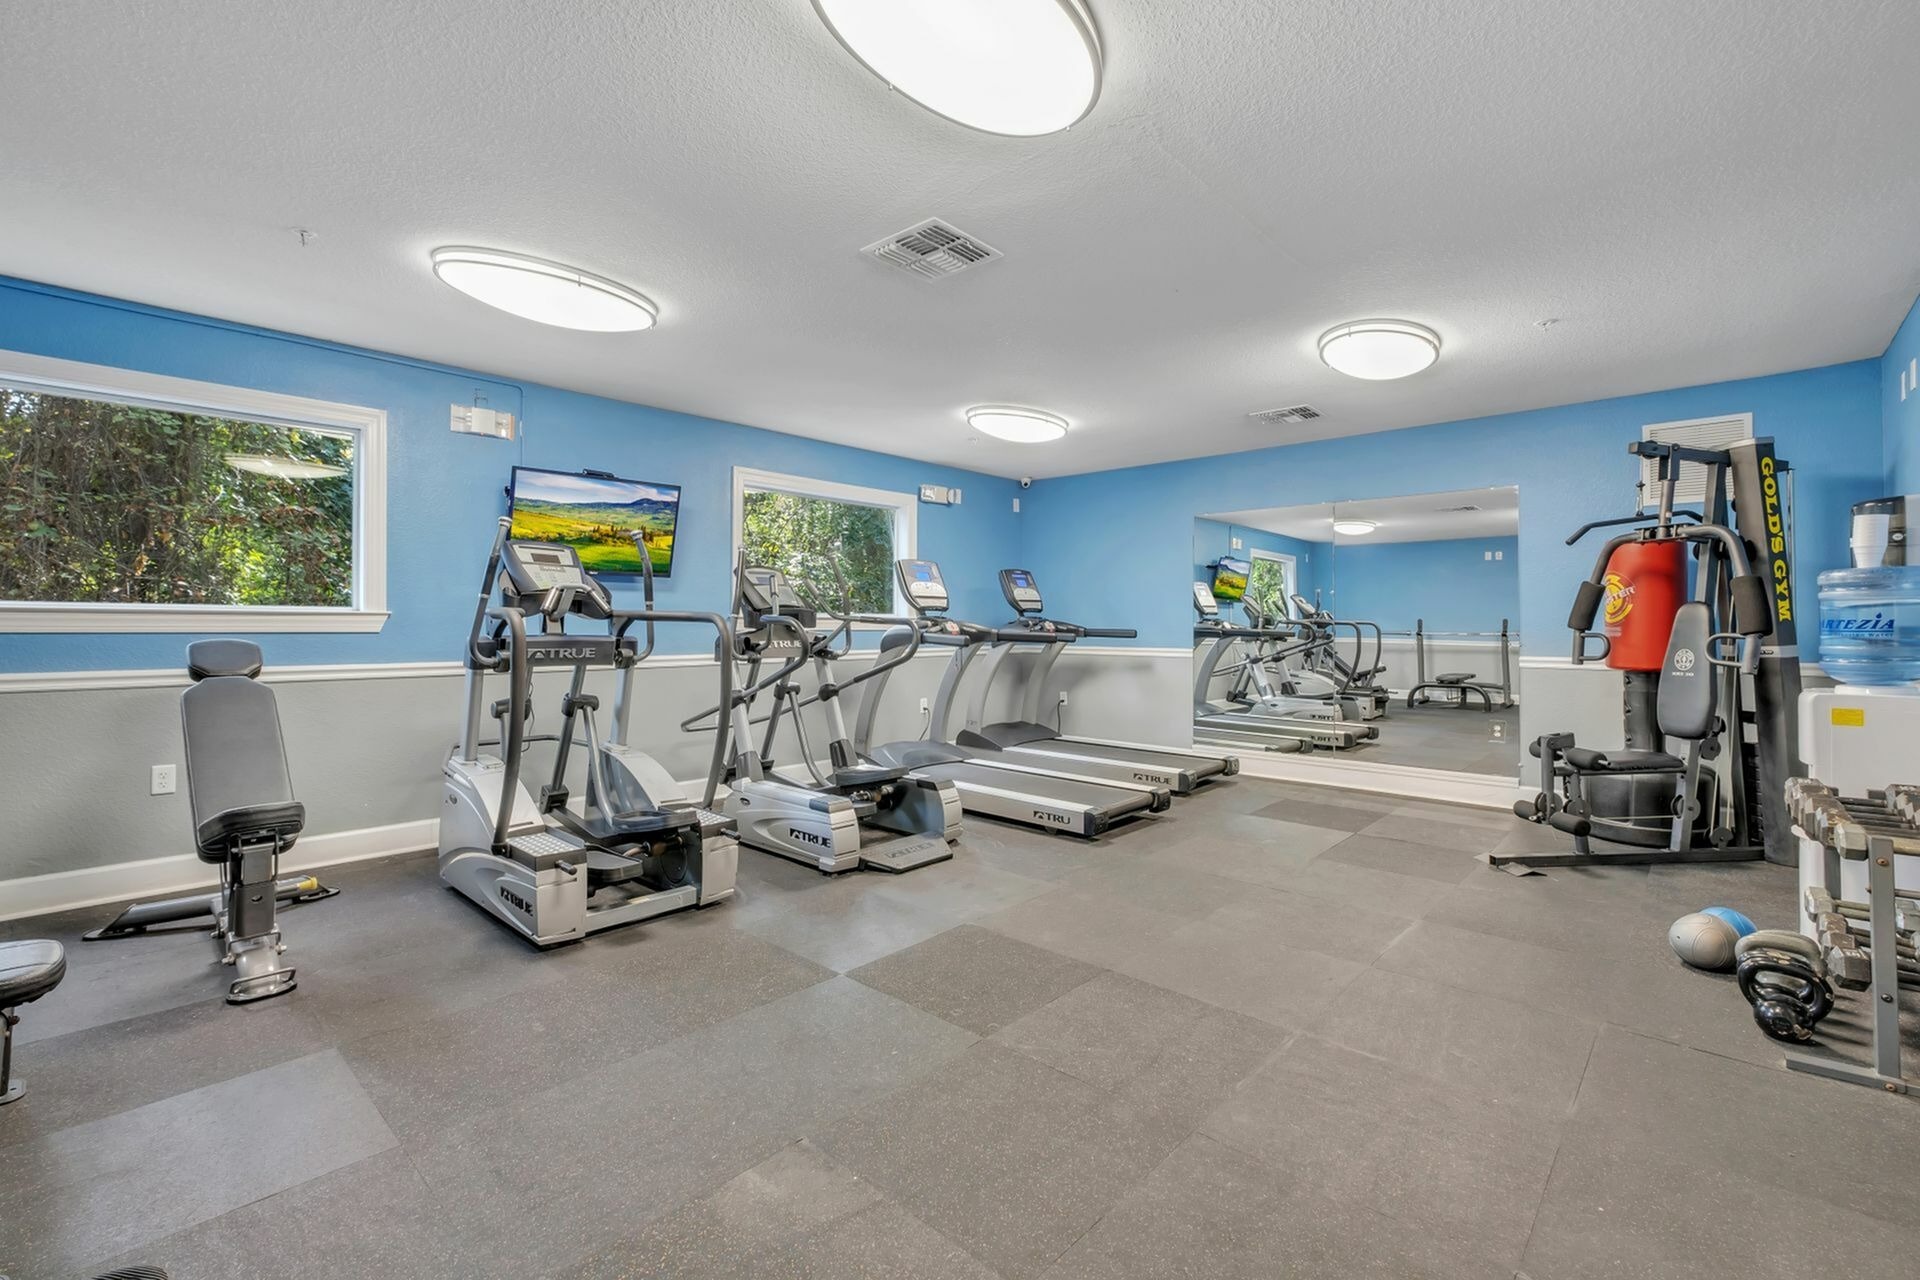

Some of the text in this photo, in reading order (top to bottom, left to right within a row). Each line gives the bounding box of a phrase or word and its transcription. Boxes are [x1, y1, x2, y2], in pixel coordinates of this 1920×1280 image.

[1760, 456, 1793, 623] GOLD'S GYM
[544, 647, 596, 659] TRUE
[801, 831, 831, 848] TRUE
